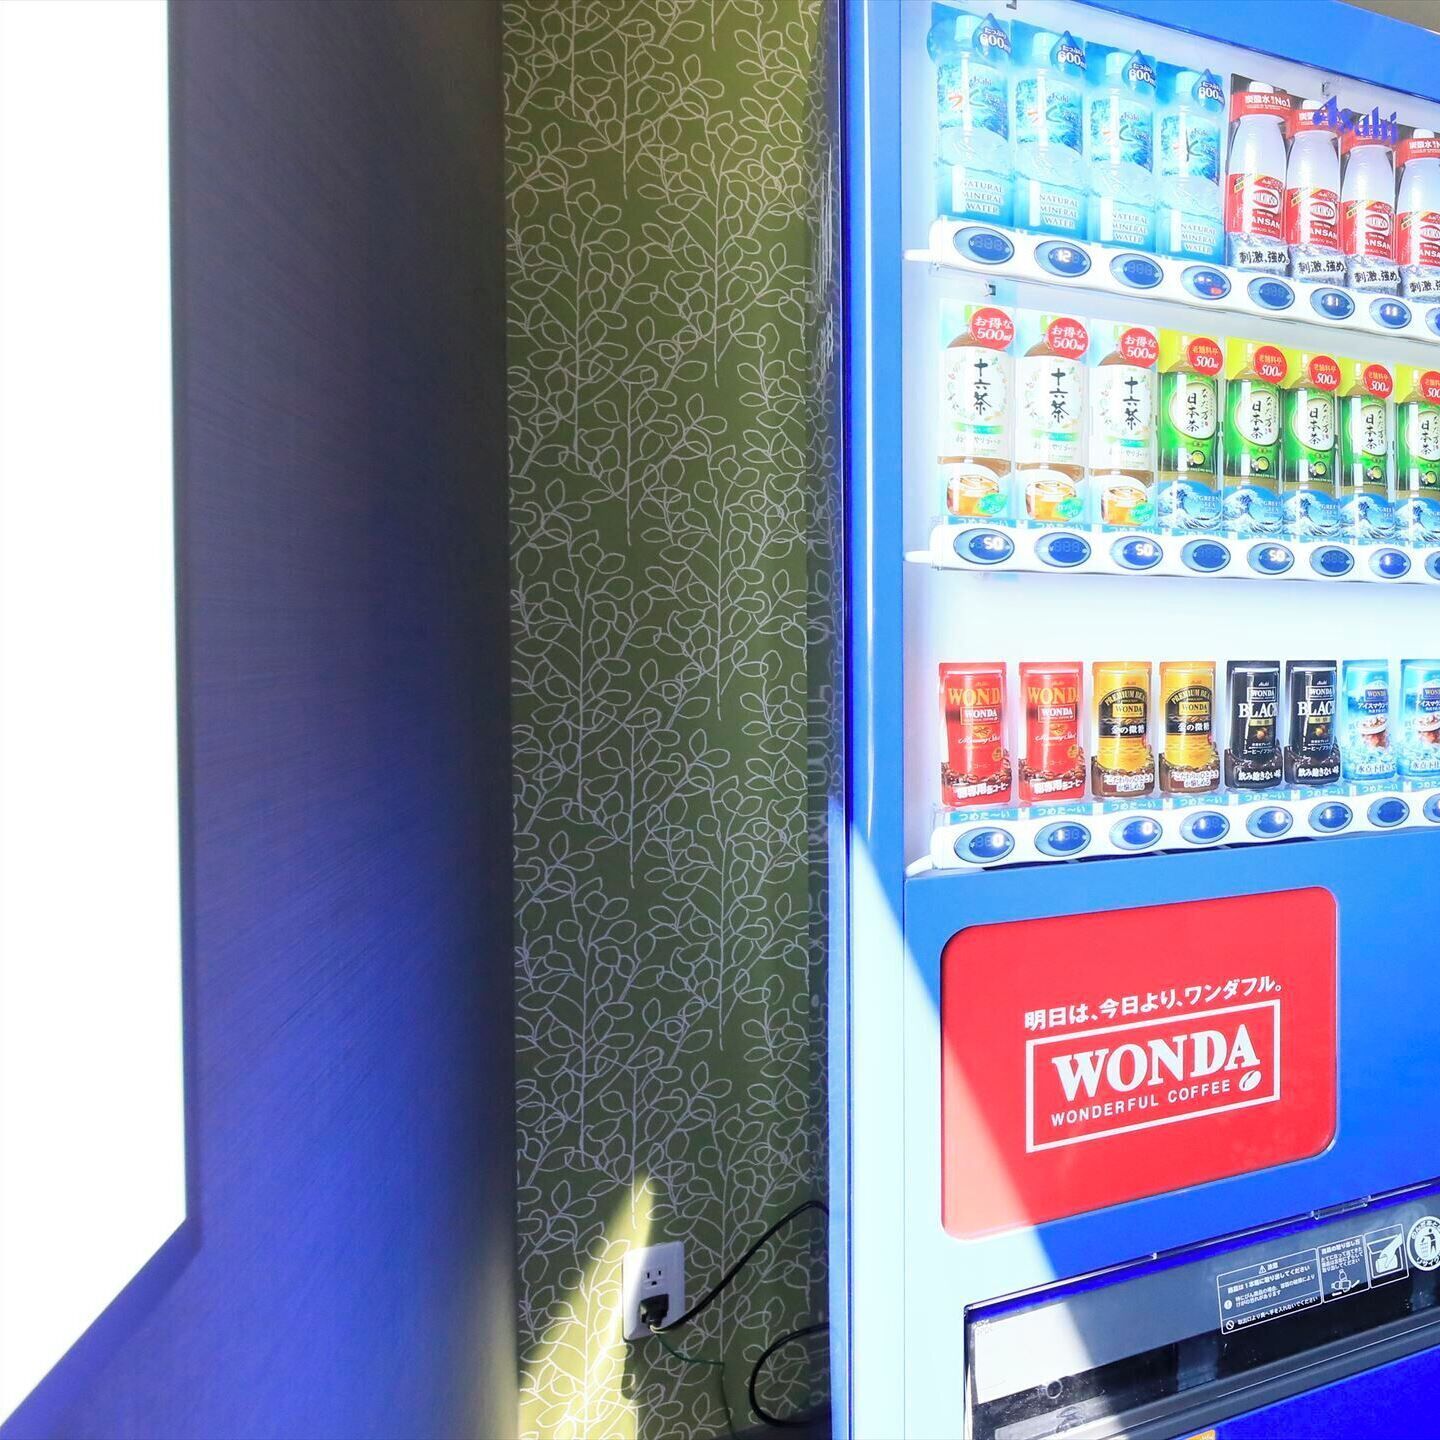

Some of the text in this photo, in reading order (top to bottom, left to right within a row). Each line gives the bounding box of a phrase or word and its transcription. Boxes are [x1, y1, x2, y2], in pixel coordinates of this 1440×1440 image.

[1312, 95, 1397, 144] Asahi
[1039, 195, 1079, 208] NATURAL
[1040, 206, 1078, 219] MINERAL
[1043, 217, 1075, 229] WATER
[1251, 216, 1280, 229] ANSAN
[1310, 228, 1338, 240] ANSAN
[1365, 239, 1391, 250] ANSAN
[975, 315, 1013, 330] お得な
[1052, 325, 1086, 339] お得な
[1124, 335, 1156, 348] お得な
[973, 358, 991, 415] 十六茶
[1049, 368, 1070, 423] 十六茶
[1123, 377, 1142, 430] 十六茶
[1186, 393, 1199, 432] 日本茶
[1251, 401, 1263, 438] 日本茶
[1308, 408, 1321, 445] 日本茶
[948, 687, 1000, 706] WOND
[1026, 686, 1080, 705] WOND
[1251, 689, 1275, 697] WONDA
[1310, 687, 1333, 696] WONDA
[965, 708, 998, 719] WONDA
[1040, 707, 1073, 717] WONDA
[1115, 704, 1143, 713] WONDA
[1181, 703, 1207, 711] WONDA
[1023, 975, 1282, 1032] 明日は、今日より、ワンダフル。
[1051, 1023, 1261, 1103] WONDA
[1050, 1078, 1231, 1127] WONDERFUL COFFEE
